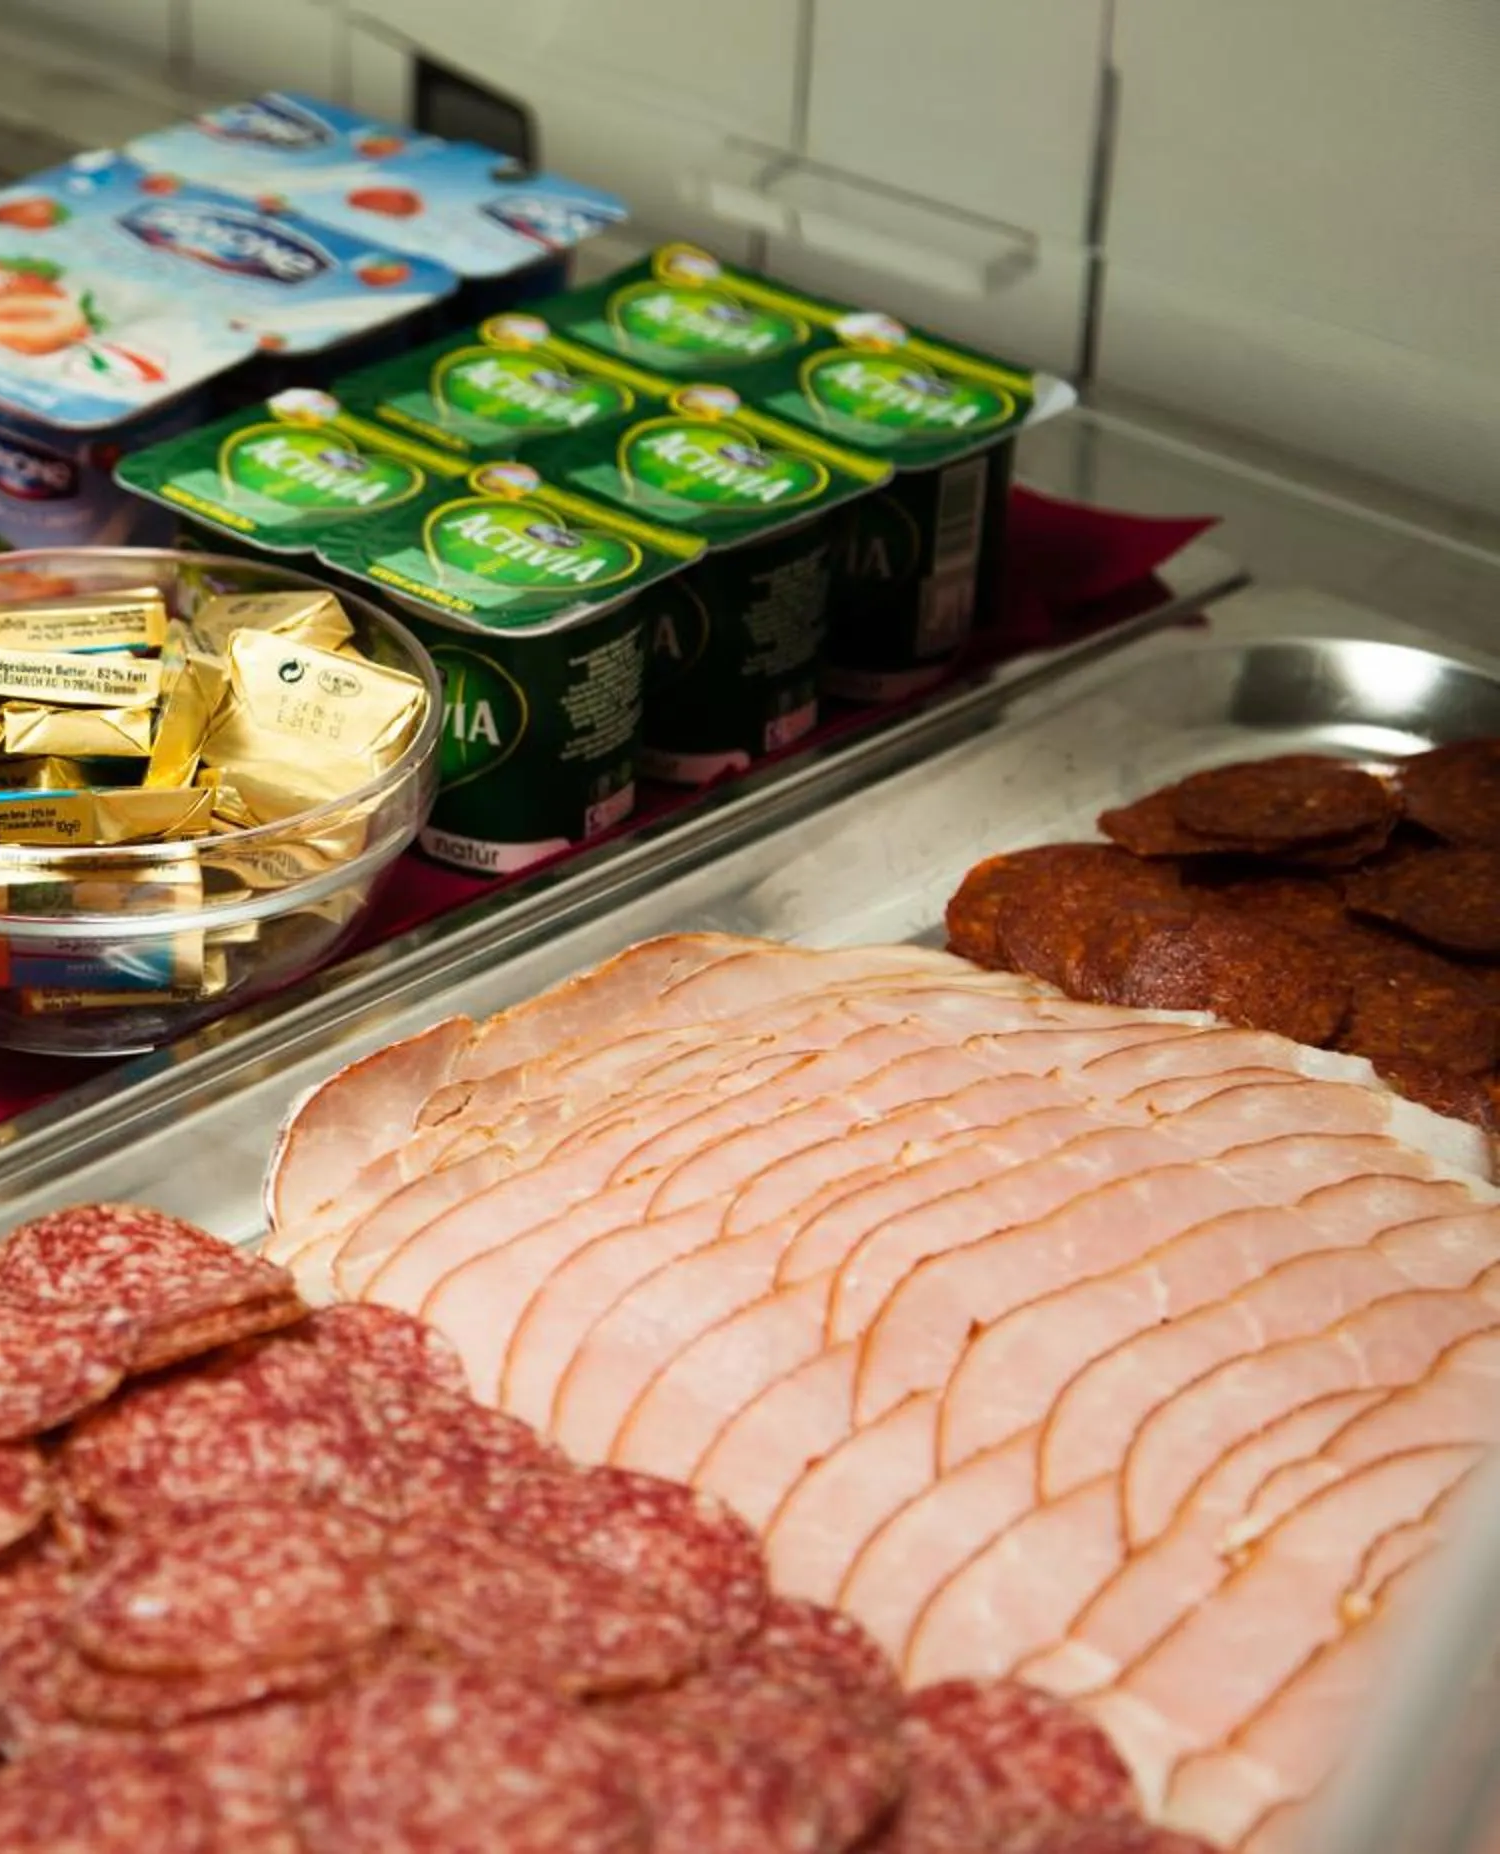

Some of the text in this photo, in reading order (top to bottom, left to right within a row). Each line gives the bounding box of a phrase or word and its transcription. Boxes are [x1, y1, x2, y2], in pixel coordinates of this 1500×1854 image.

[632, 294, 776, 354] ACTIVIA
[452, 360, 601, 428] ACTIVIA
[817, 360, 980, 428] ACTIVIA
[243, 437, 390, 507] ACTIVIA
[642, 431, 795, 503] ACTIVIA
[445, 511, 611, 585] ACTIVIA
